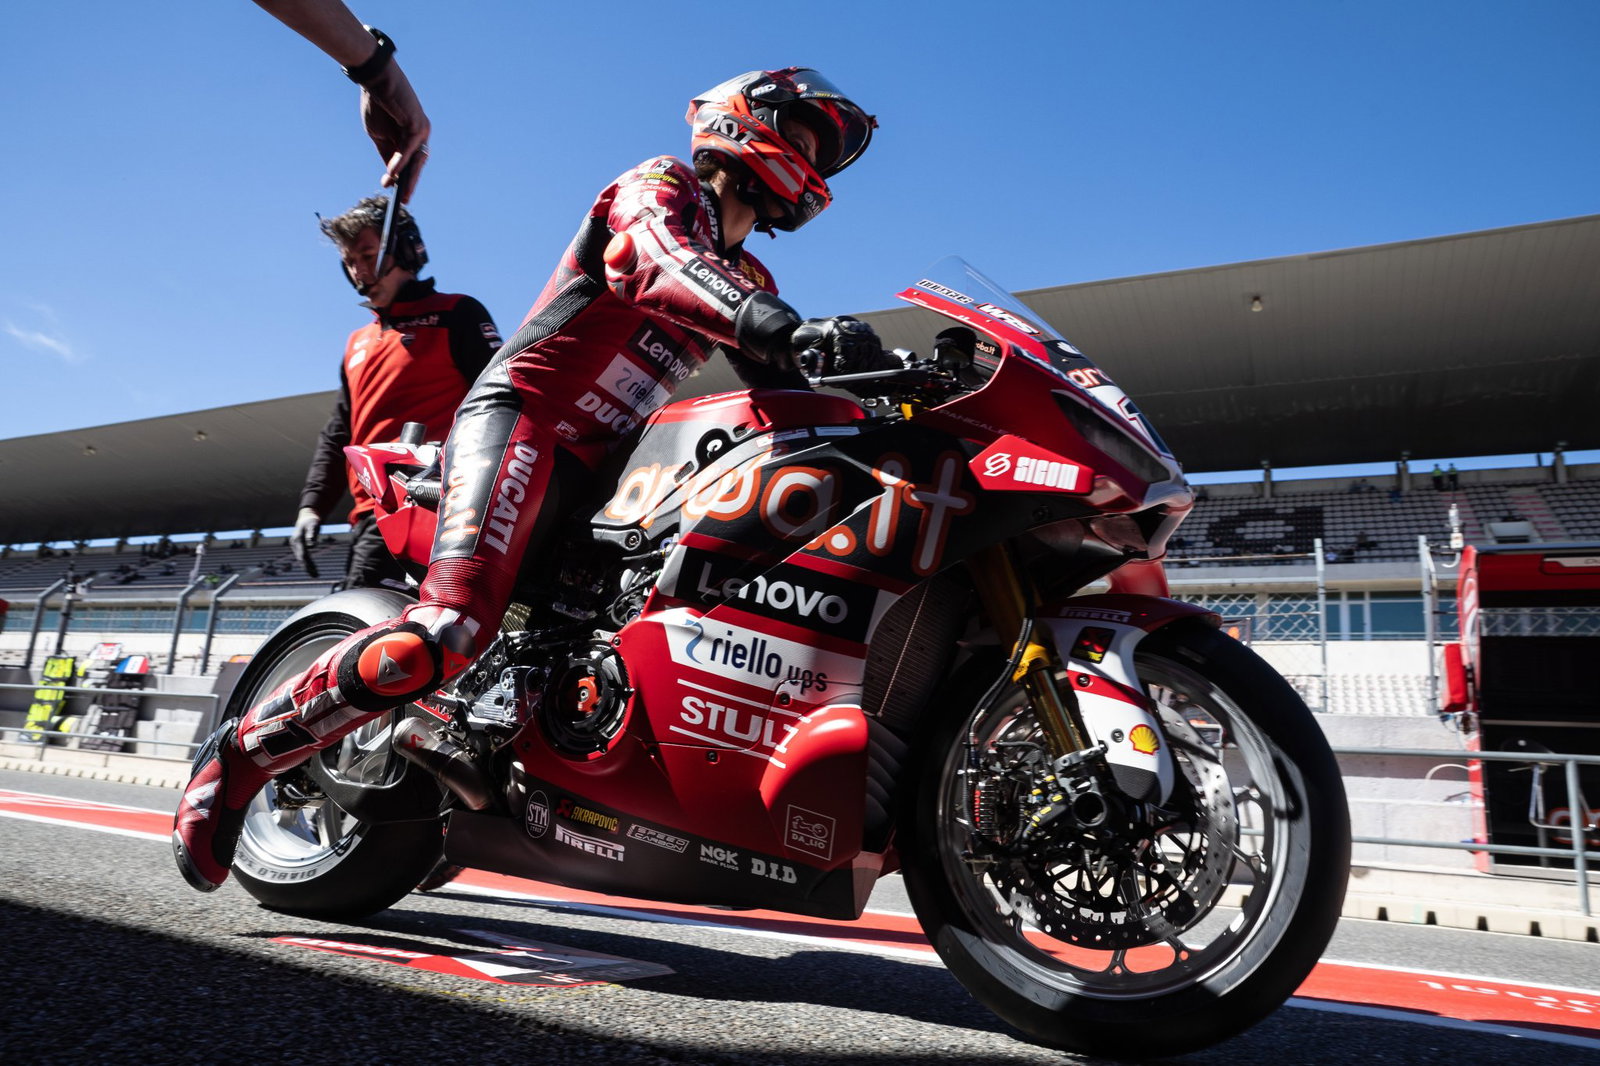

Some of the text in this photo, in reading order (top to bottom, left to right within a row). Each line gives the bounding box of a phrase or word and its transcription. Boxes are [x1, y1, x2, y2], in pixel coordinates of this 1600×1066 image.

[689, 261, 741, 302] Lenovo
[638, 329, 689, 380] Lenovo
[626, 380, 656, 406] rieo
[575, 391, 637, 435] DUC
[484, 440, 538, 555] DUCATI
[696, 561, 848, 624] Lenovo
[1059, 606, 1132, 623] PIRELLI
[710, 630, 829, 695] riello ups
[680, 696, 799, 753] STULZ
[527, 803, 548, 826] STM
[555, 823, 625, 862] PIRELLI
[634, 832, 683, 851] CARBON
[700, 844, 739, 865] NGK
[257, 867, 317, 881] DIABLO
[700, 856, 739, 871] SPARK PLUGS
[751, 857, 798, 884] D.I.D
